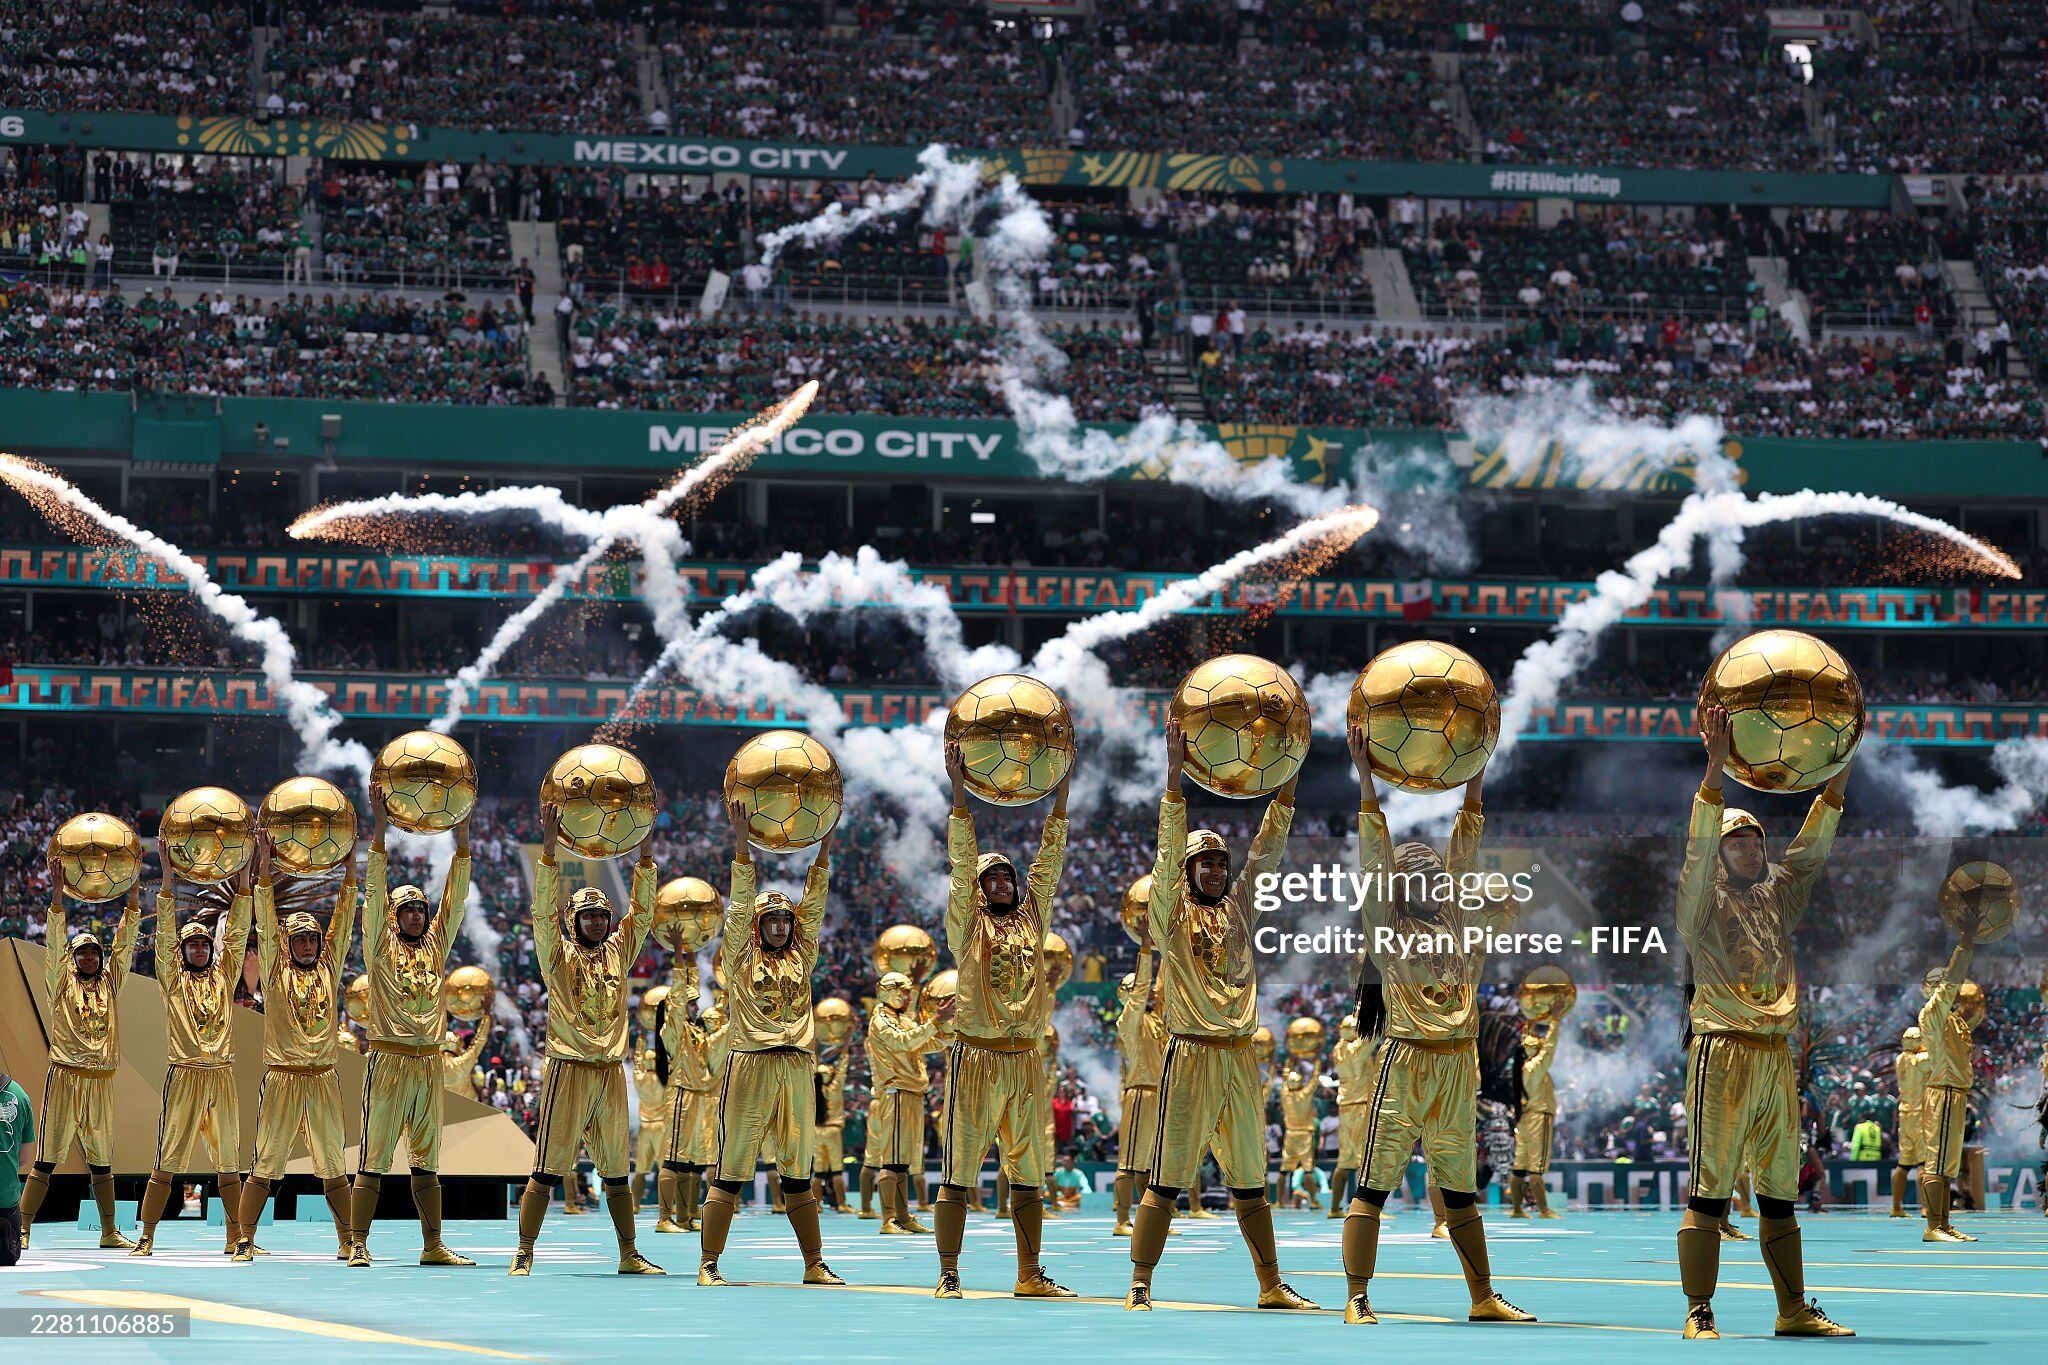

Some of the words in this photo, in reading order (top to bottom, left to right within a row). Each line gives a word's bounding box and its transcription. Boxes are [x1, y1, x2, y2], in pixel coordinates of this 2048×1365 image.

[574, 140, 740, 167] MEXICO
[749, 147, 848, 170] CITY
[1491, 171, 1621, 198] #FIFAWorldCup
[649, 425, 864, 456] MEICO
[876, 430, 1002, 459] CITY
[42, 551, 128, 582] FIFA
[297, 558, 383, 589] FIFA
[1037, 576, 1120, 606] FIFA
[1753, 591, 1834, 622] FIFA
[1988, 594, 2048, 622] FIF
[133, 677, 219, 708] FIFA
[882, 695, 956, 724] FIF
[1603, 706, 1685, 736] FIFA
[1865, 711, 1921, 739] IFA
